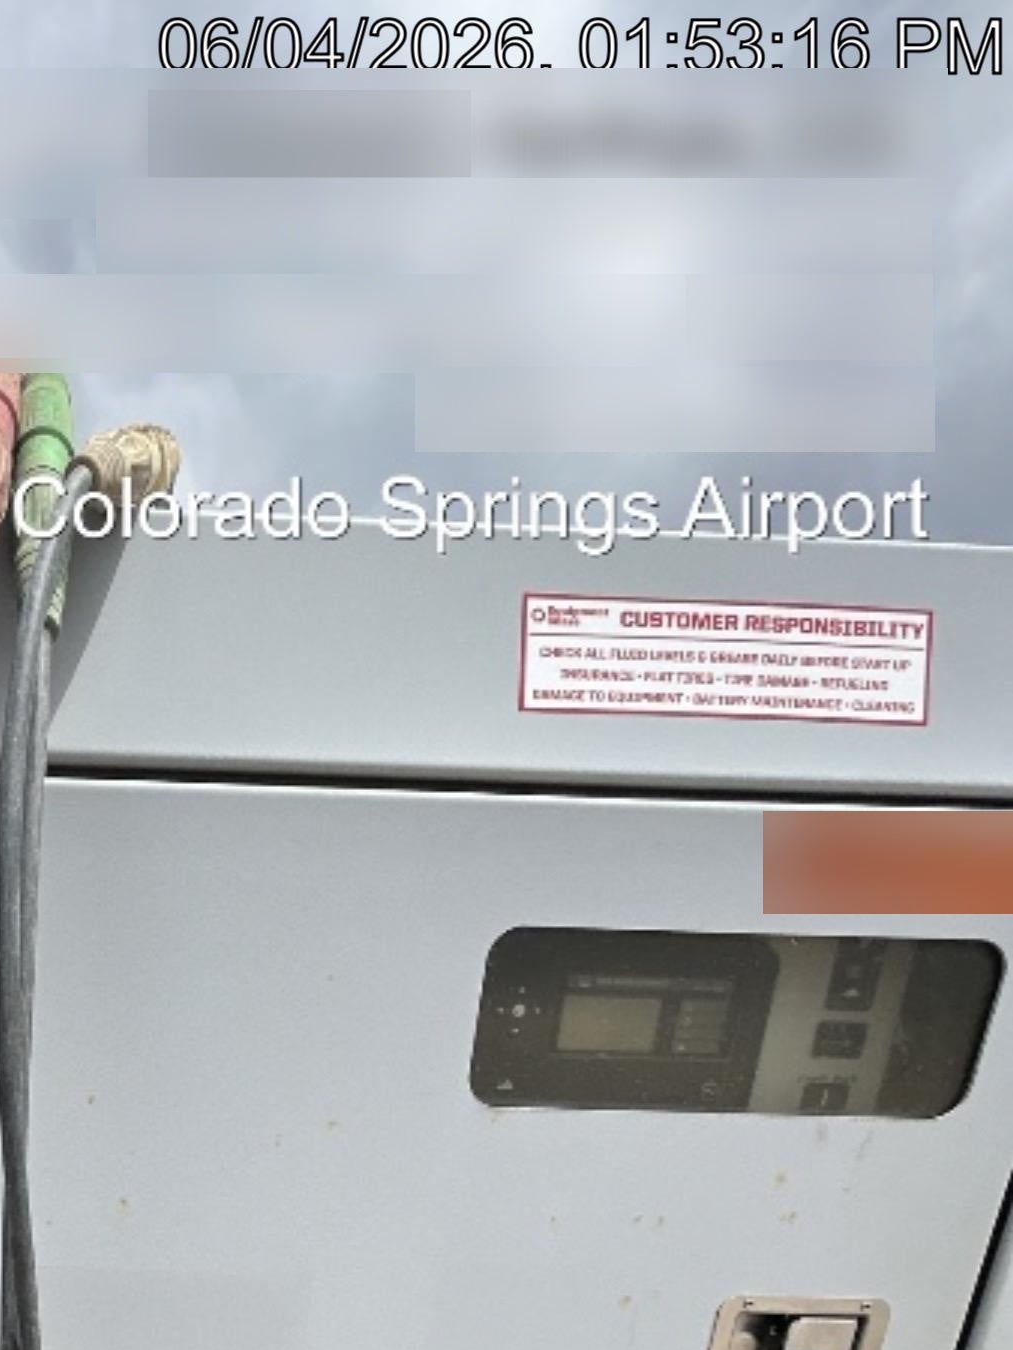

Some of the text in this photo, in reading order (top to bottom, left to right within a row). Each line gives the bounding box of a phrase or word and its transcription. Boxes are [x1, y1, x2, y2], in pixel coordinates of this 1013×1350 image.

[620, 610, 924, 640] CUSTOMER RESPONSIBILITY
[585, 647, 606, 660] ALL
[589, 689, 605, 702] TO
